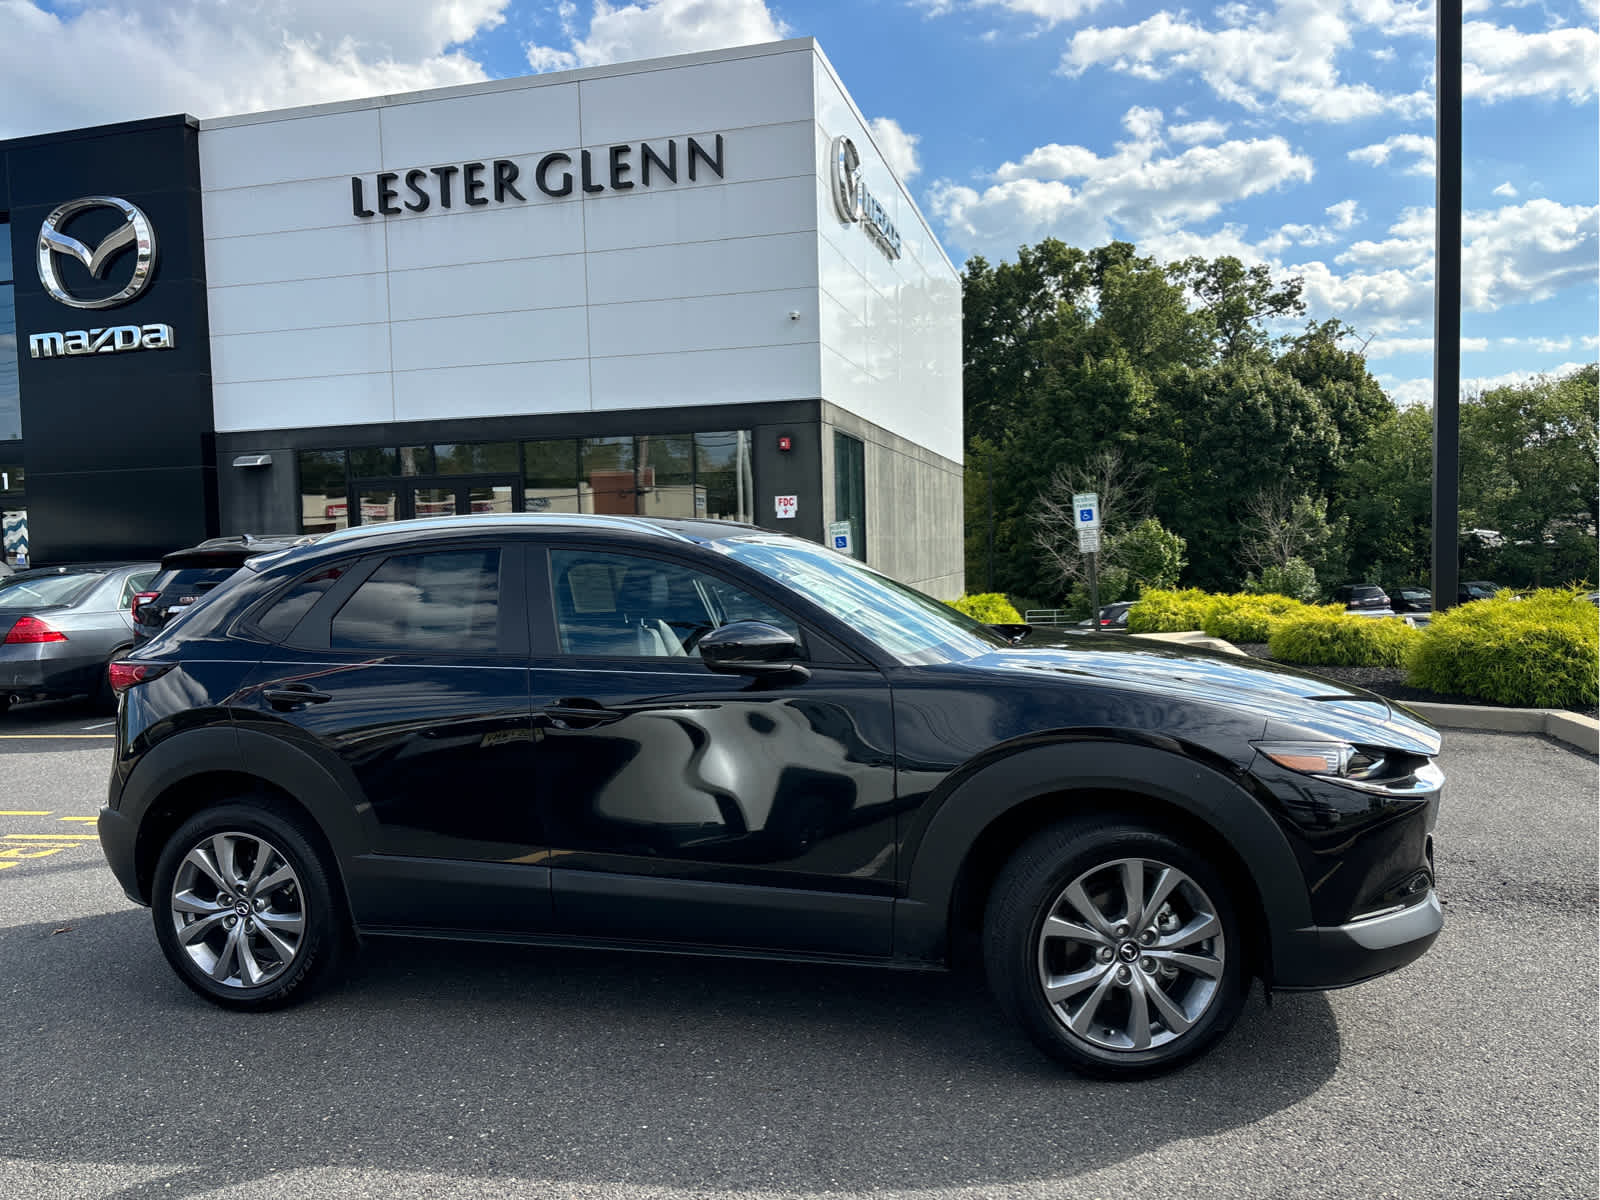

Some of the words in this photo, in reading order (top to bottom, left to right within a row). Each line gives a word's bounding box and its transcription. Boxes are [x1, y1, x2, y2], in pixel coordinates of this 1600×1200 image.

[351, 160, 527, 218] LESTER
[535, 133, 724, 198] GLENN
[29, 323, 174, 359] mazda
[778, 497, 795, 507] FDC
